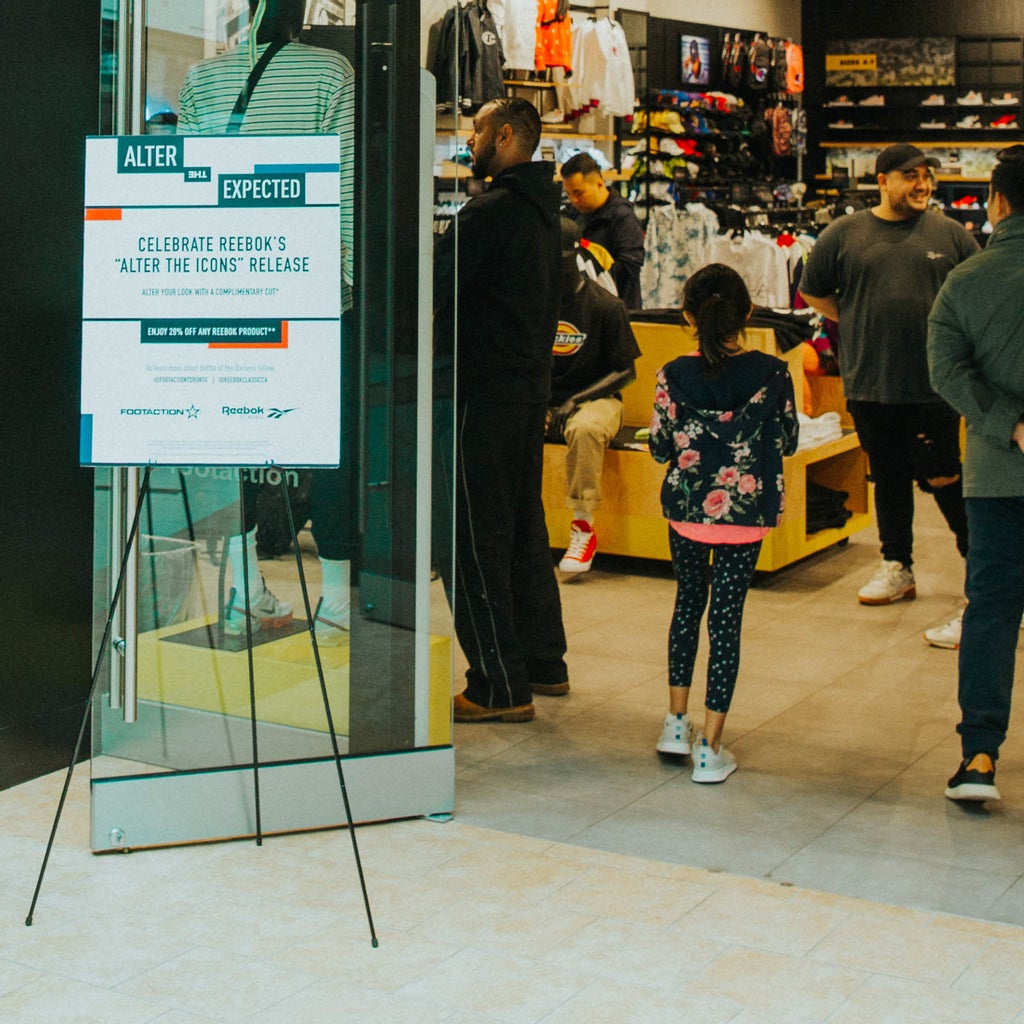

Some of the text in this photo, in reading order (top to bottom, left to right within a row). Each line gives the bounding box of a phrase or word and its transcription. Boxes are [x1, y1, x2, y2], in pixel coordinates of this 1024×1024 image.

[124, 145, 177, 167] ALTER
[188, 170, 208, 179] THE
[223, 179, 301, 199] EXPECTED
[138, 236, 286, 252] CELEBRATE REEBOK'S
[114, 257, 310, 273] “ALTER THE ICONS” RELEASE
[142, 288, 159, 296] ALTER
[161, 288, 177, 296] YOUR
[178, 288, 193, 296] LOOK
[194, 288, 209, 296] WITH
[210, 288, 214, 296] A
[215, 288, 264, 296] COMPLIMENTARY
[147, 327, 167, 336] ENJOY
[184, 327, 196, 336] OFF
[198, 327, 211, 336] ANY
[212, 327, 237, 336] REEBOK
[222, 406, 264, 416] Reebok
